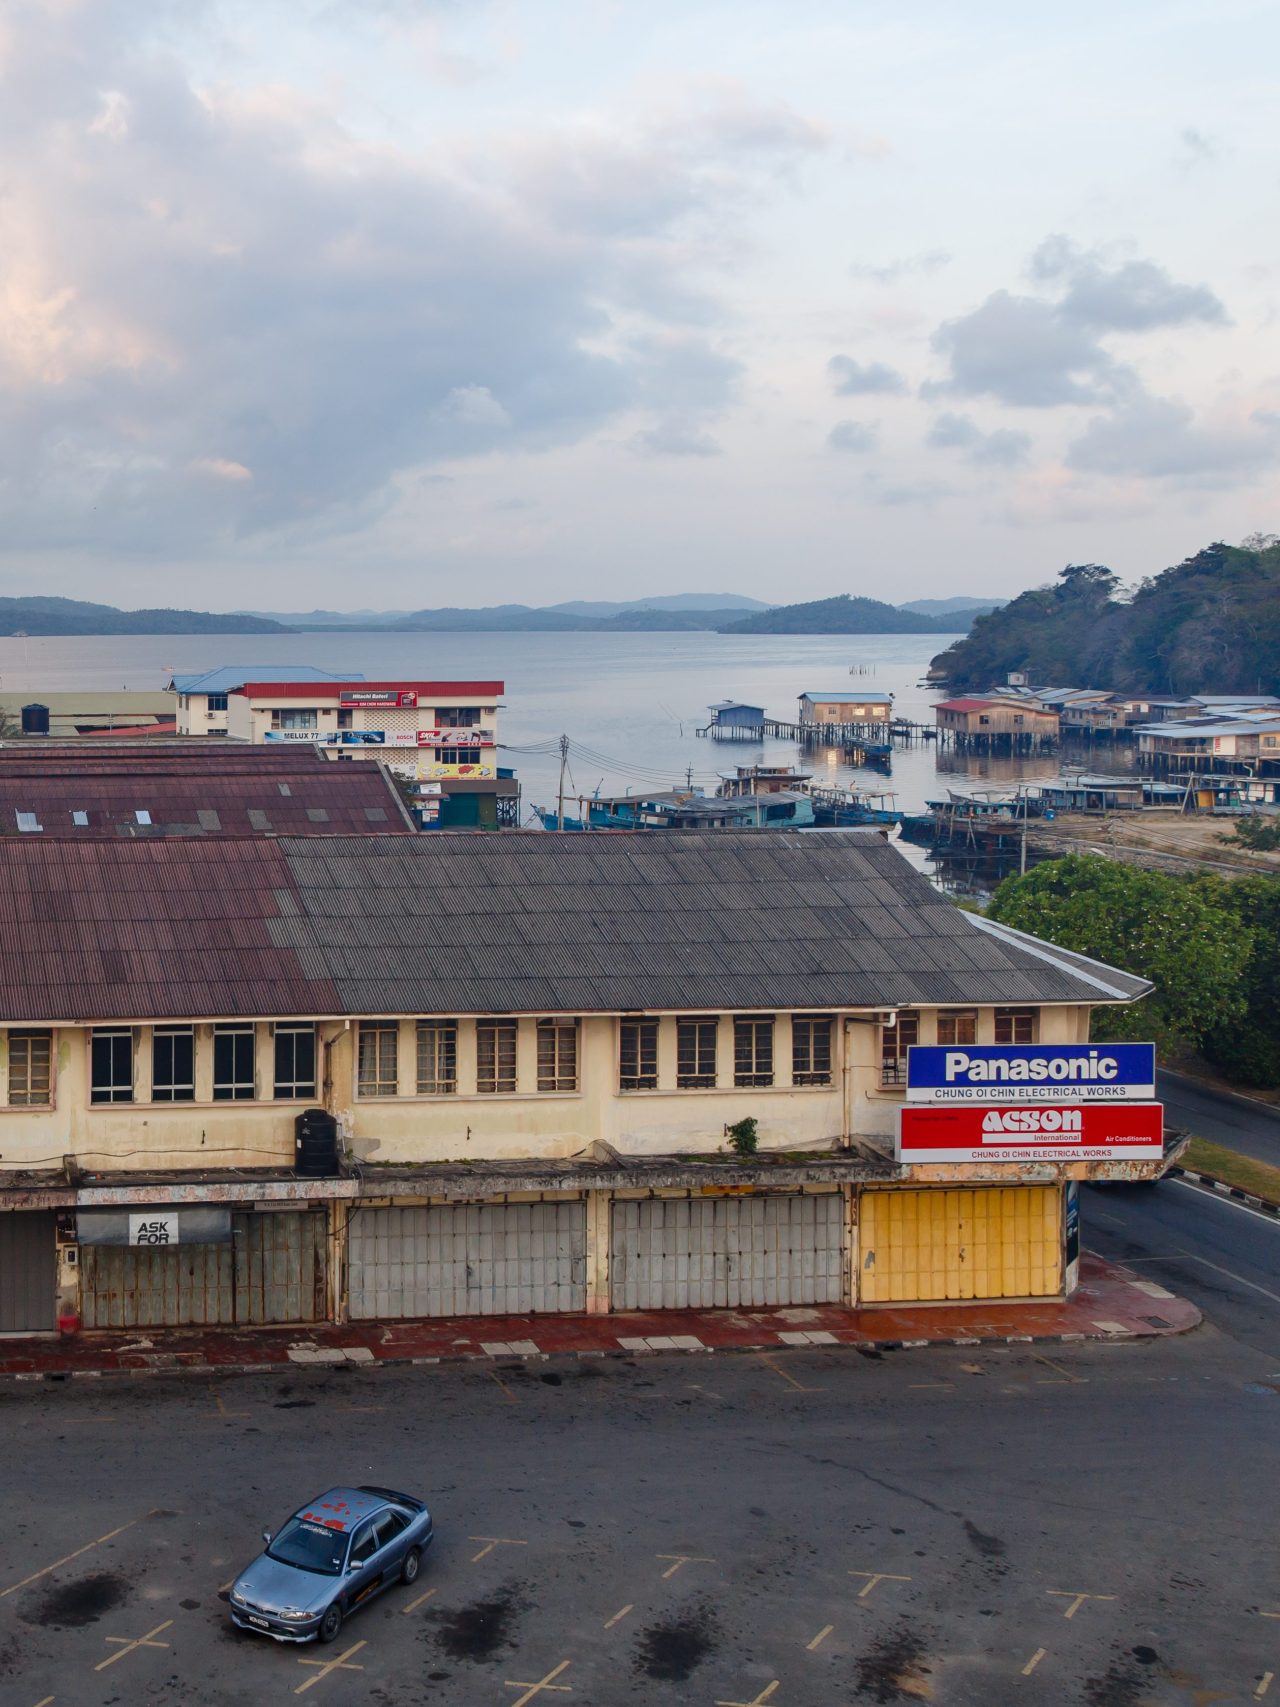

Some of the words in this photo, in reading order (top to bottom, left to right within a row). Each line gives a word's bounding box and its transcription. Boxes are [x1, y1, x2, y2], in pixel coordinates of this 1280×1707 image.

[945, 1051, 1118, 1081] Panasonic
[935, 1089, 973, 1098] CHUNG
[976, 1089, 987, 1098] OI
[990, 1088, 1016, 1098] CHIN
[1018, 1087, 1084, 1097] ELECTRICAL
[1087, 1086, 1126, 1096] WORKS
[1034, 1133, 1080, 1142] International
[971, 1151, 1001, 1159] CHUNG
[1012, 1150, 1032, 1158] CHIN
[1032, 1150, 1082, 1158] ELECTRICAL
[1082, 1149, 1112, 1157] WORKS
[137, 1221, 169, 1233] ASK
[137, 1233, 170, 1244] FOR
